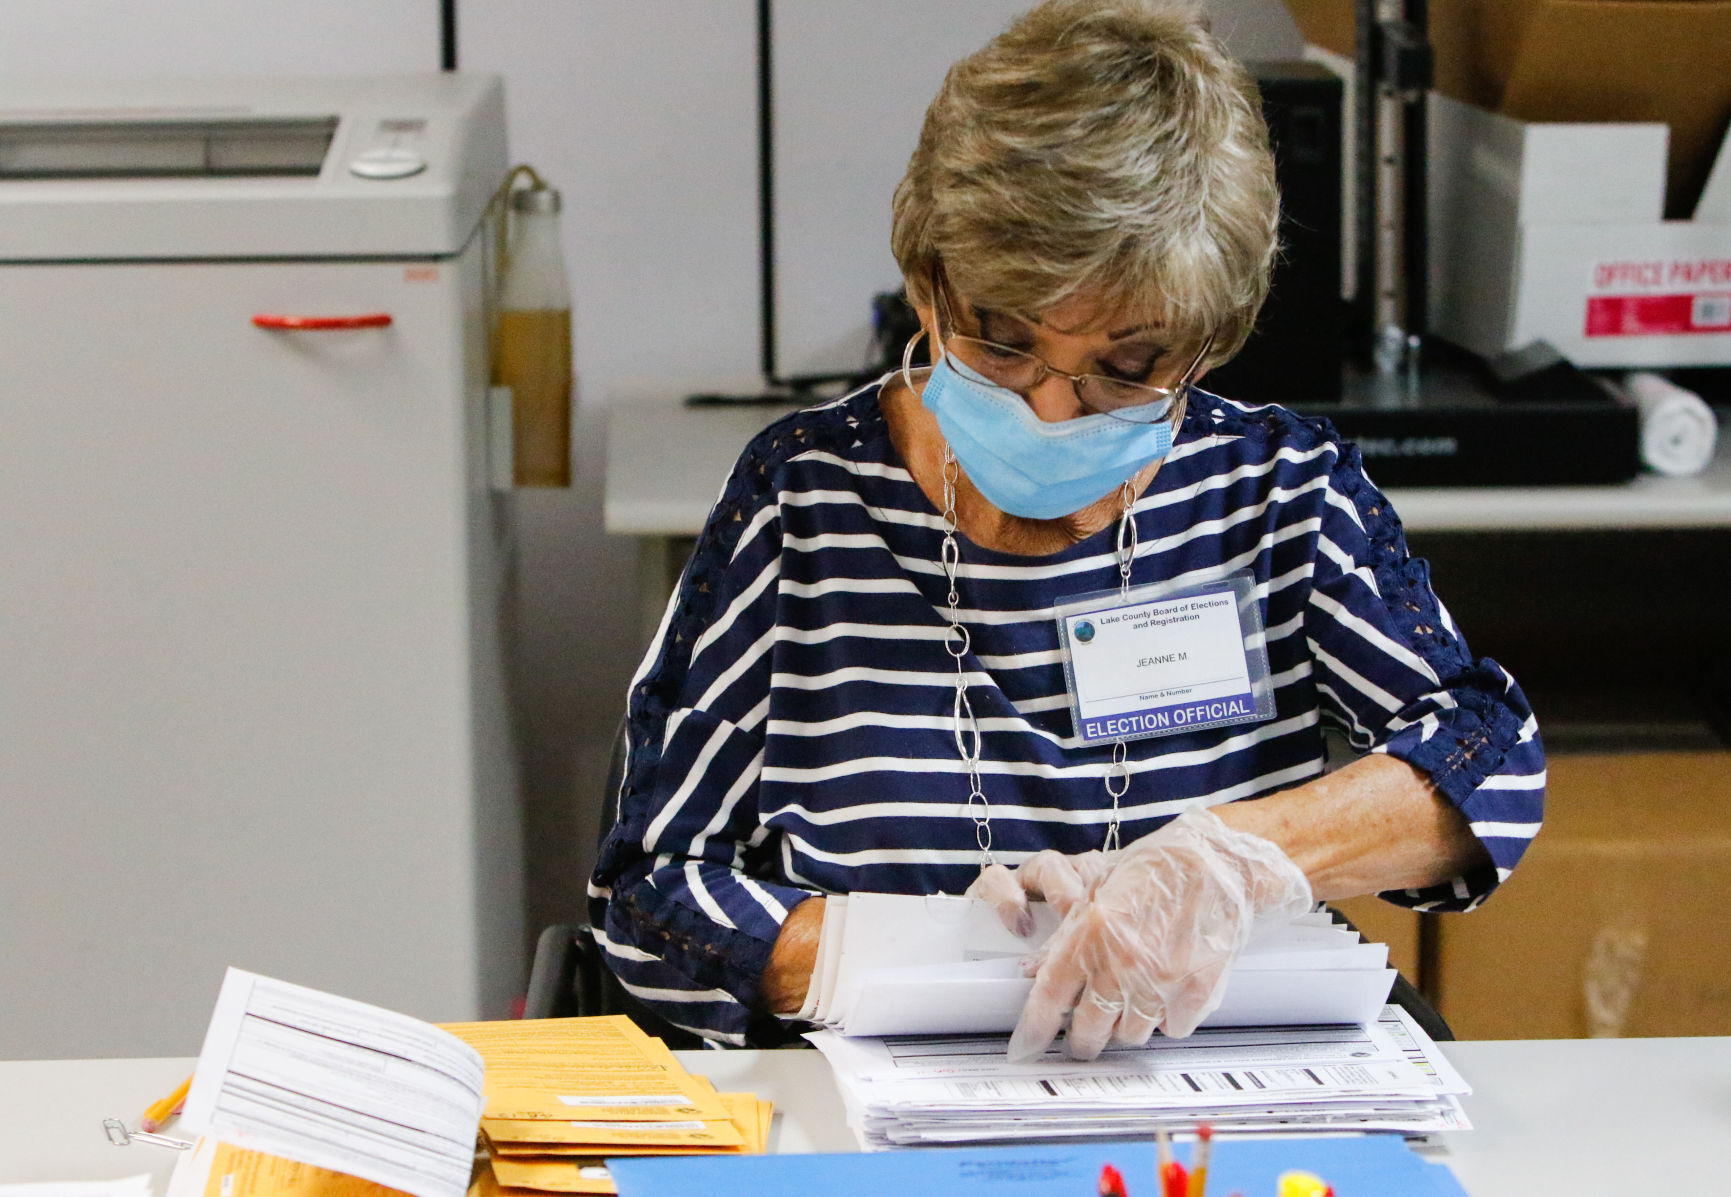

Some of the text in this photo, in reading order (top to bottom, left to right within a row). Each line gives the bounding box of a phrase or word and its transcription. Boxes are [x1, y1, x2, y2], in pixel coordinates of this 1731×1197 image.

[1100, 599, 1229, 625] Lake County Board of Elections
[1133, 613, 1200, 630] and Registration
[1136, 652, 1187, 668] JEANNE M
[1166, 688, 1193, 697] Number
[1086, 699, 1250, 738] ELECTION OFFICIAL
